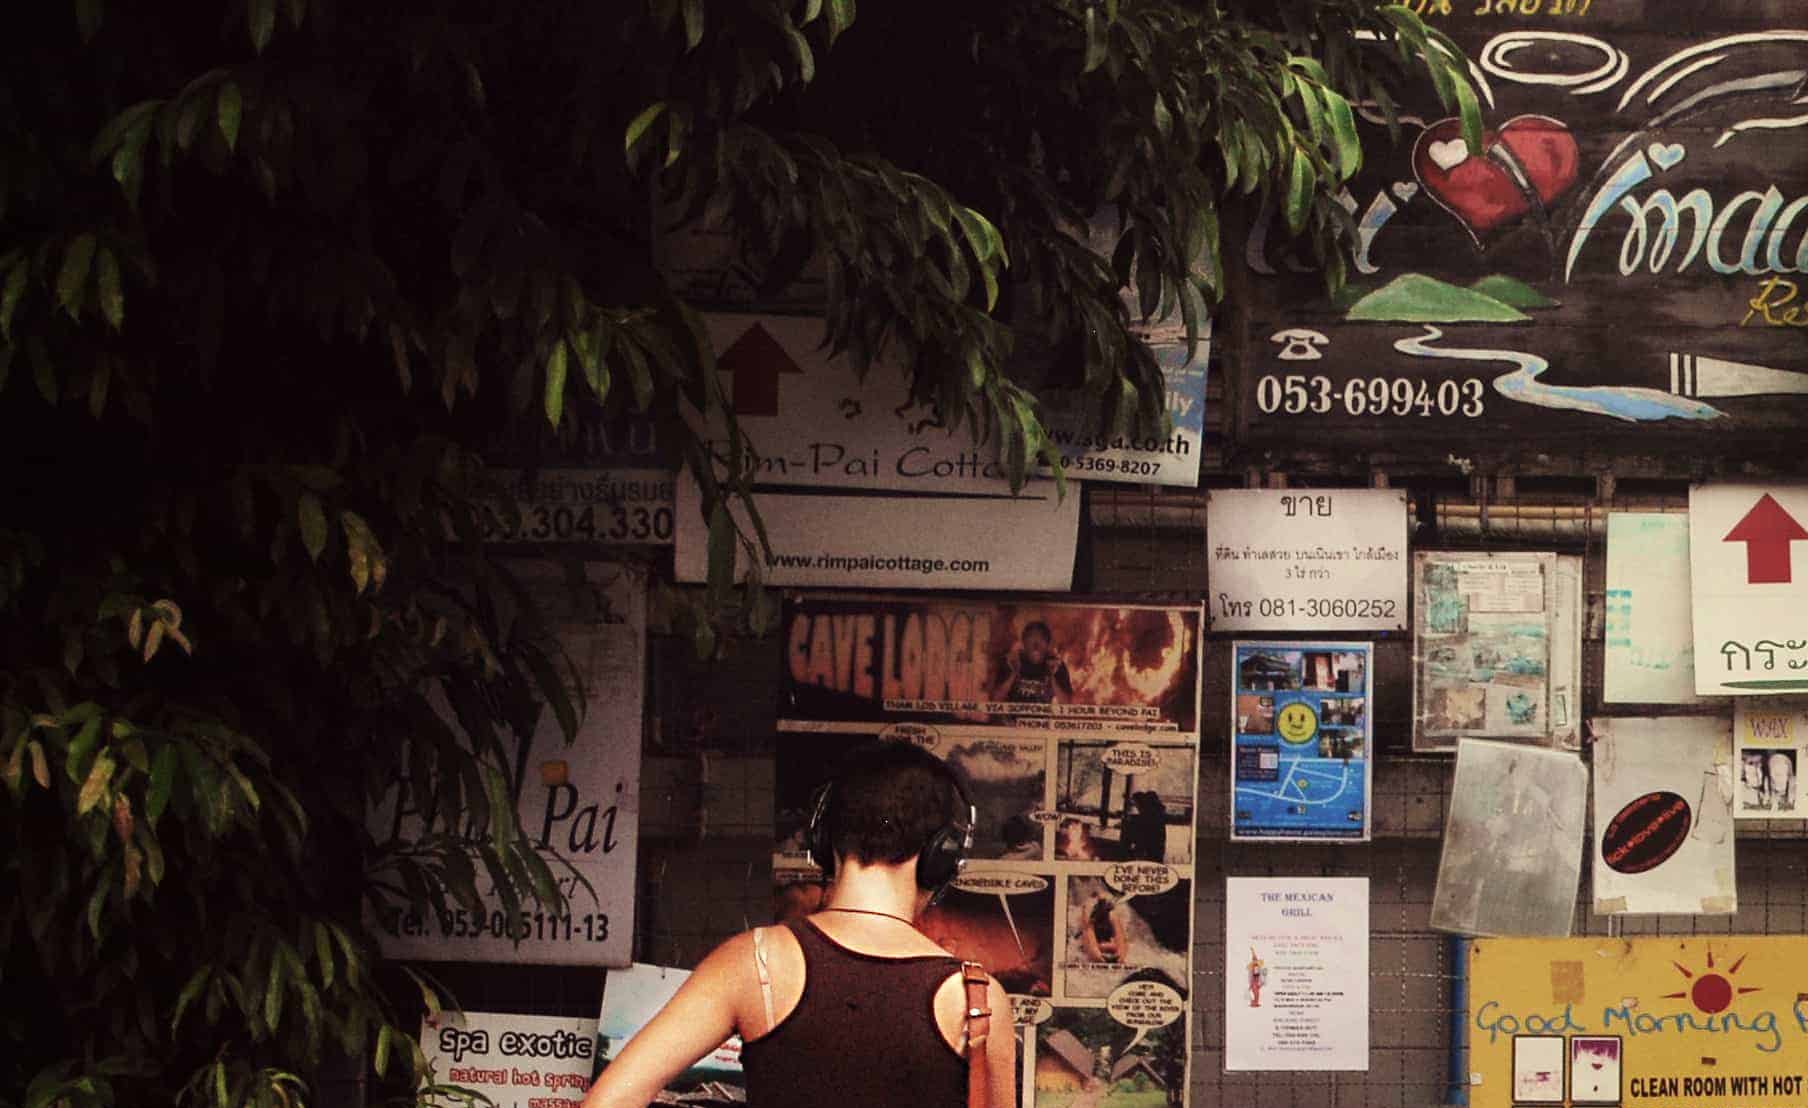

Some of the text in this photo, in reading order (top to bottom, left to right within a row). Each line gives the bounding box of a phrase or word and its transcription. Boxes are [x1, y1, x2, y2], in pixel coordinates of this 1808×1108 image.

[1257, 375, 1485, 419] 053-699403
[1061, 455, 1160, 475] 0-5369-8207
[1280, 496, 1332, 517] ขาย
[1219, 593, 1396, 618] โทร 081-3060252
[789, 610, 992, 723] CAVE LODGE
[1068, 706, 1157, 716] HOUR BEYOND PAI
[1017, 719, 1050, 729] PHONE
[537, 782, 620, 854] Pai
[1113, 874, 1169, 884] DONE THIS
[1137, 865, 1168, 875] NEVER
[1261, 893, 1334, 902] THE MEXICAN
[1281, 908, 1312, 917] GRILL
[1477, 1001, 1586, 1044] Good
[1603, 1004, 1782, 1052] Morning
[440, 1029, 593, 1062] spa exotic
[450, 1067, 540, 1085] natural hot
[1630, 1076, 1679, 1098] CLEAN
[1684, 1076, 1727, 1097] ROOM
[1730, 1076, 1769, 1096] WITH
[1773, 1076, 1803, 1096] HOT
